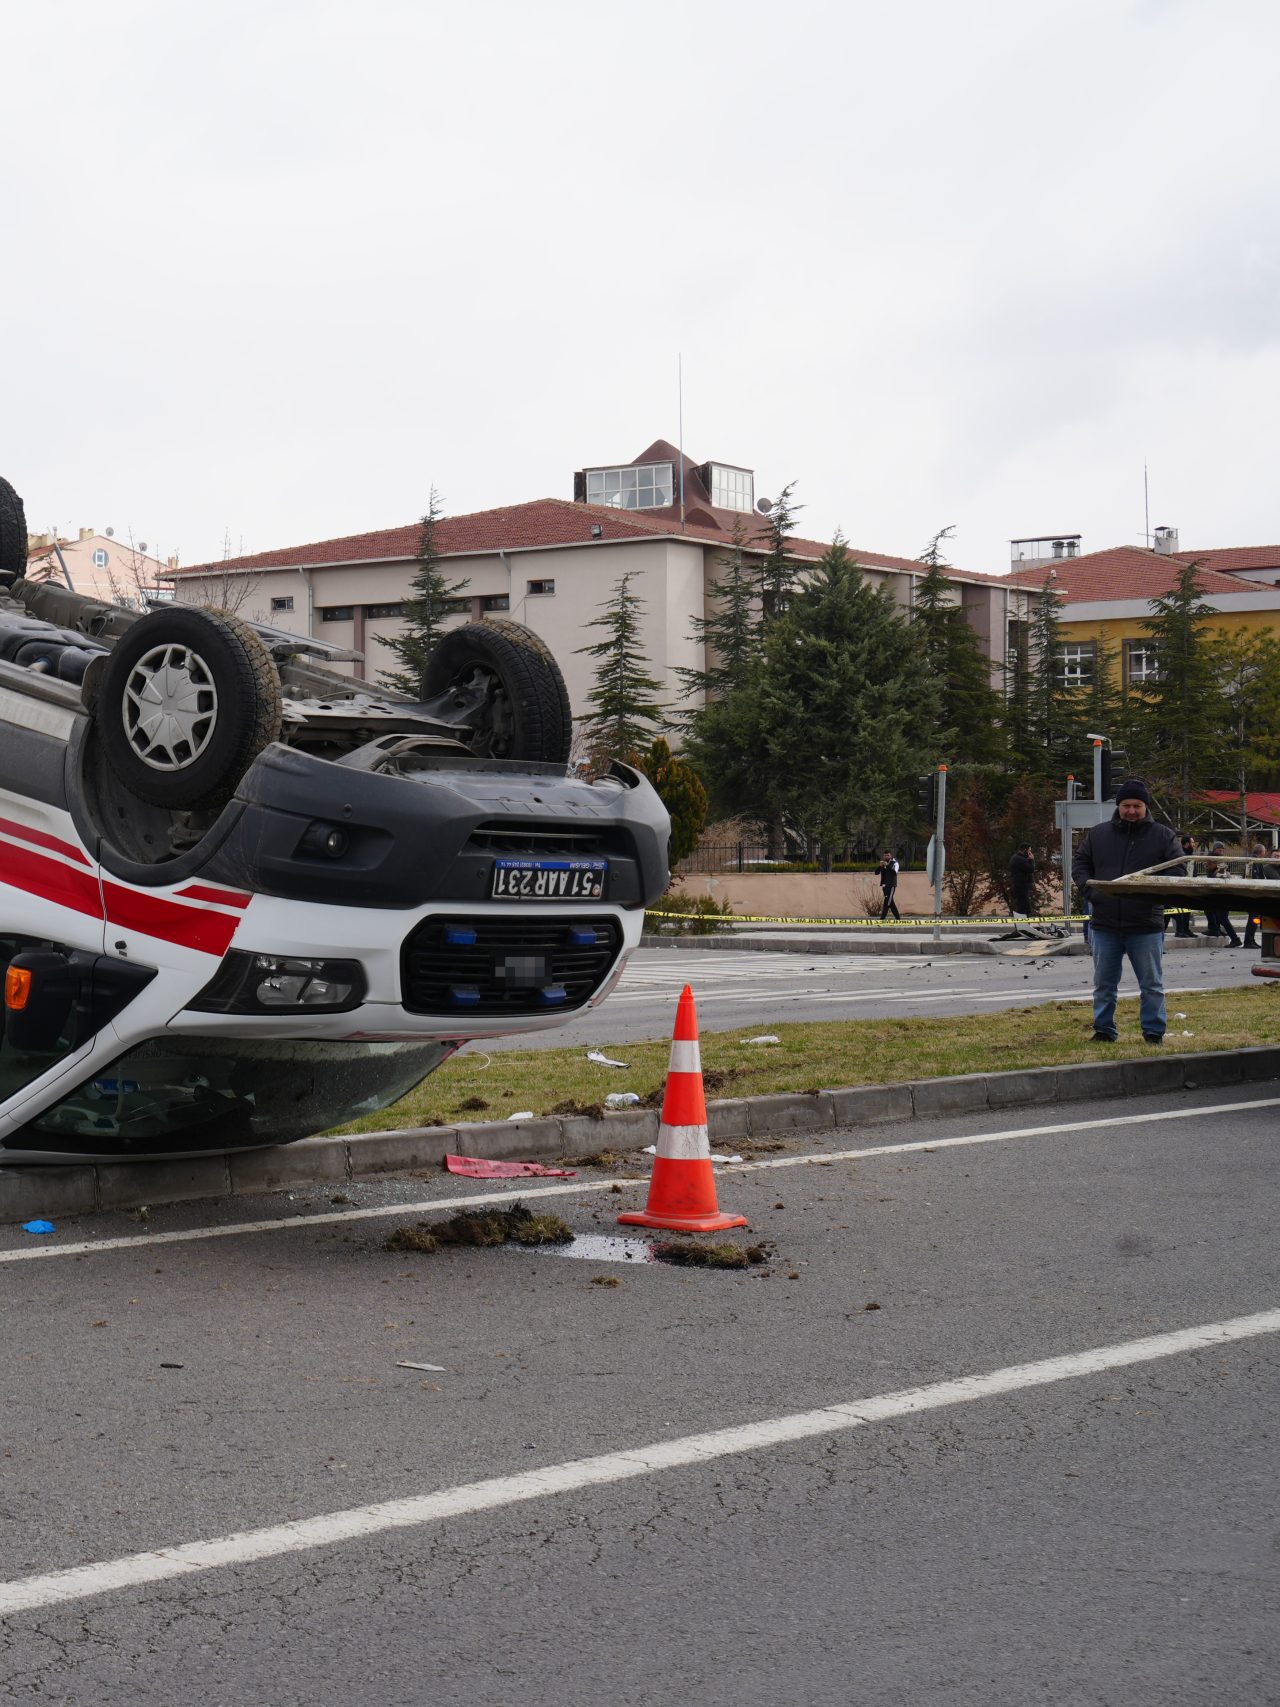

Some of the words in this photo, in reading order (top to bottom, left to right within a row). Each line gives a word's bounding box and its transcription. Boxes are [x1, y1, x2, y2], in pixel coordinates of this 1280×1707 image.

[497, 869, 533, 894] 231
[534, 870, 570, 895] AAR
[571, 871, 593, 895] 51
